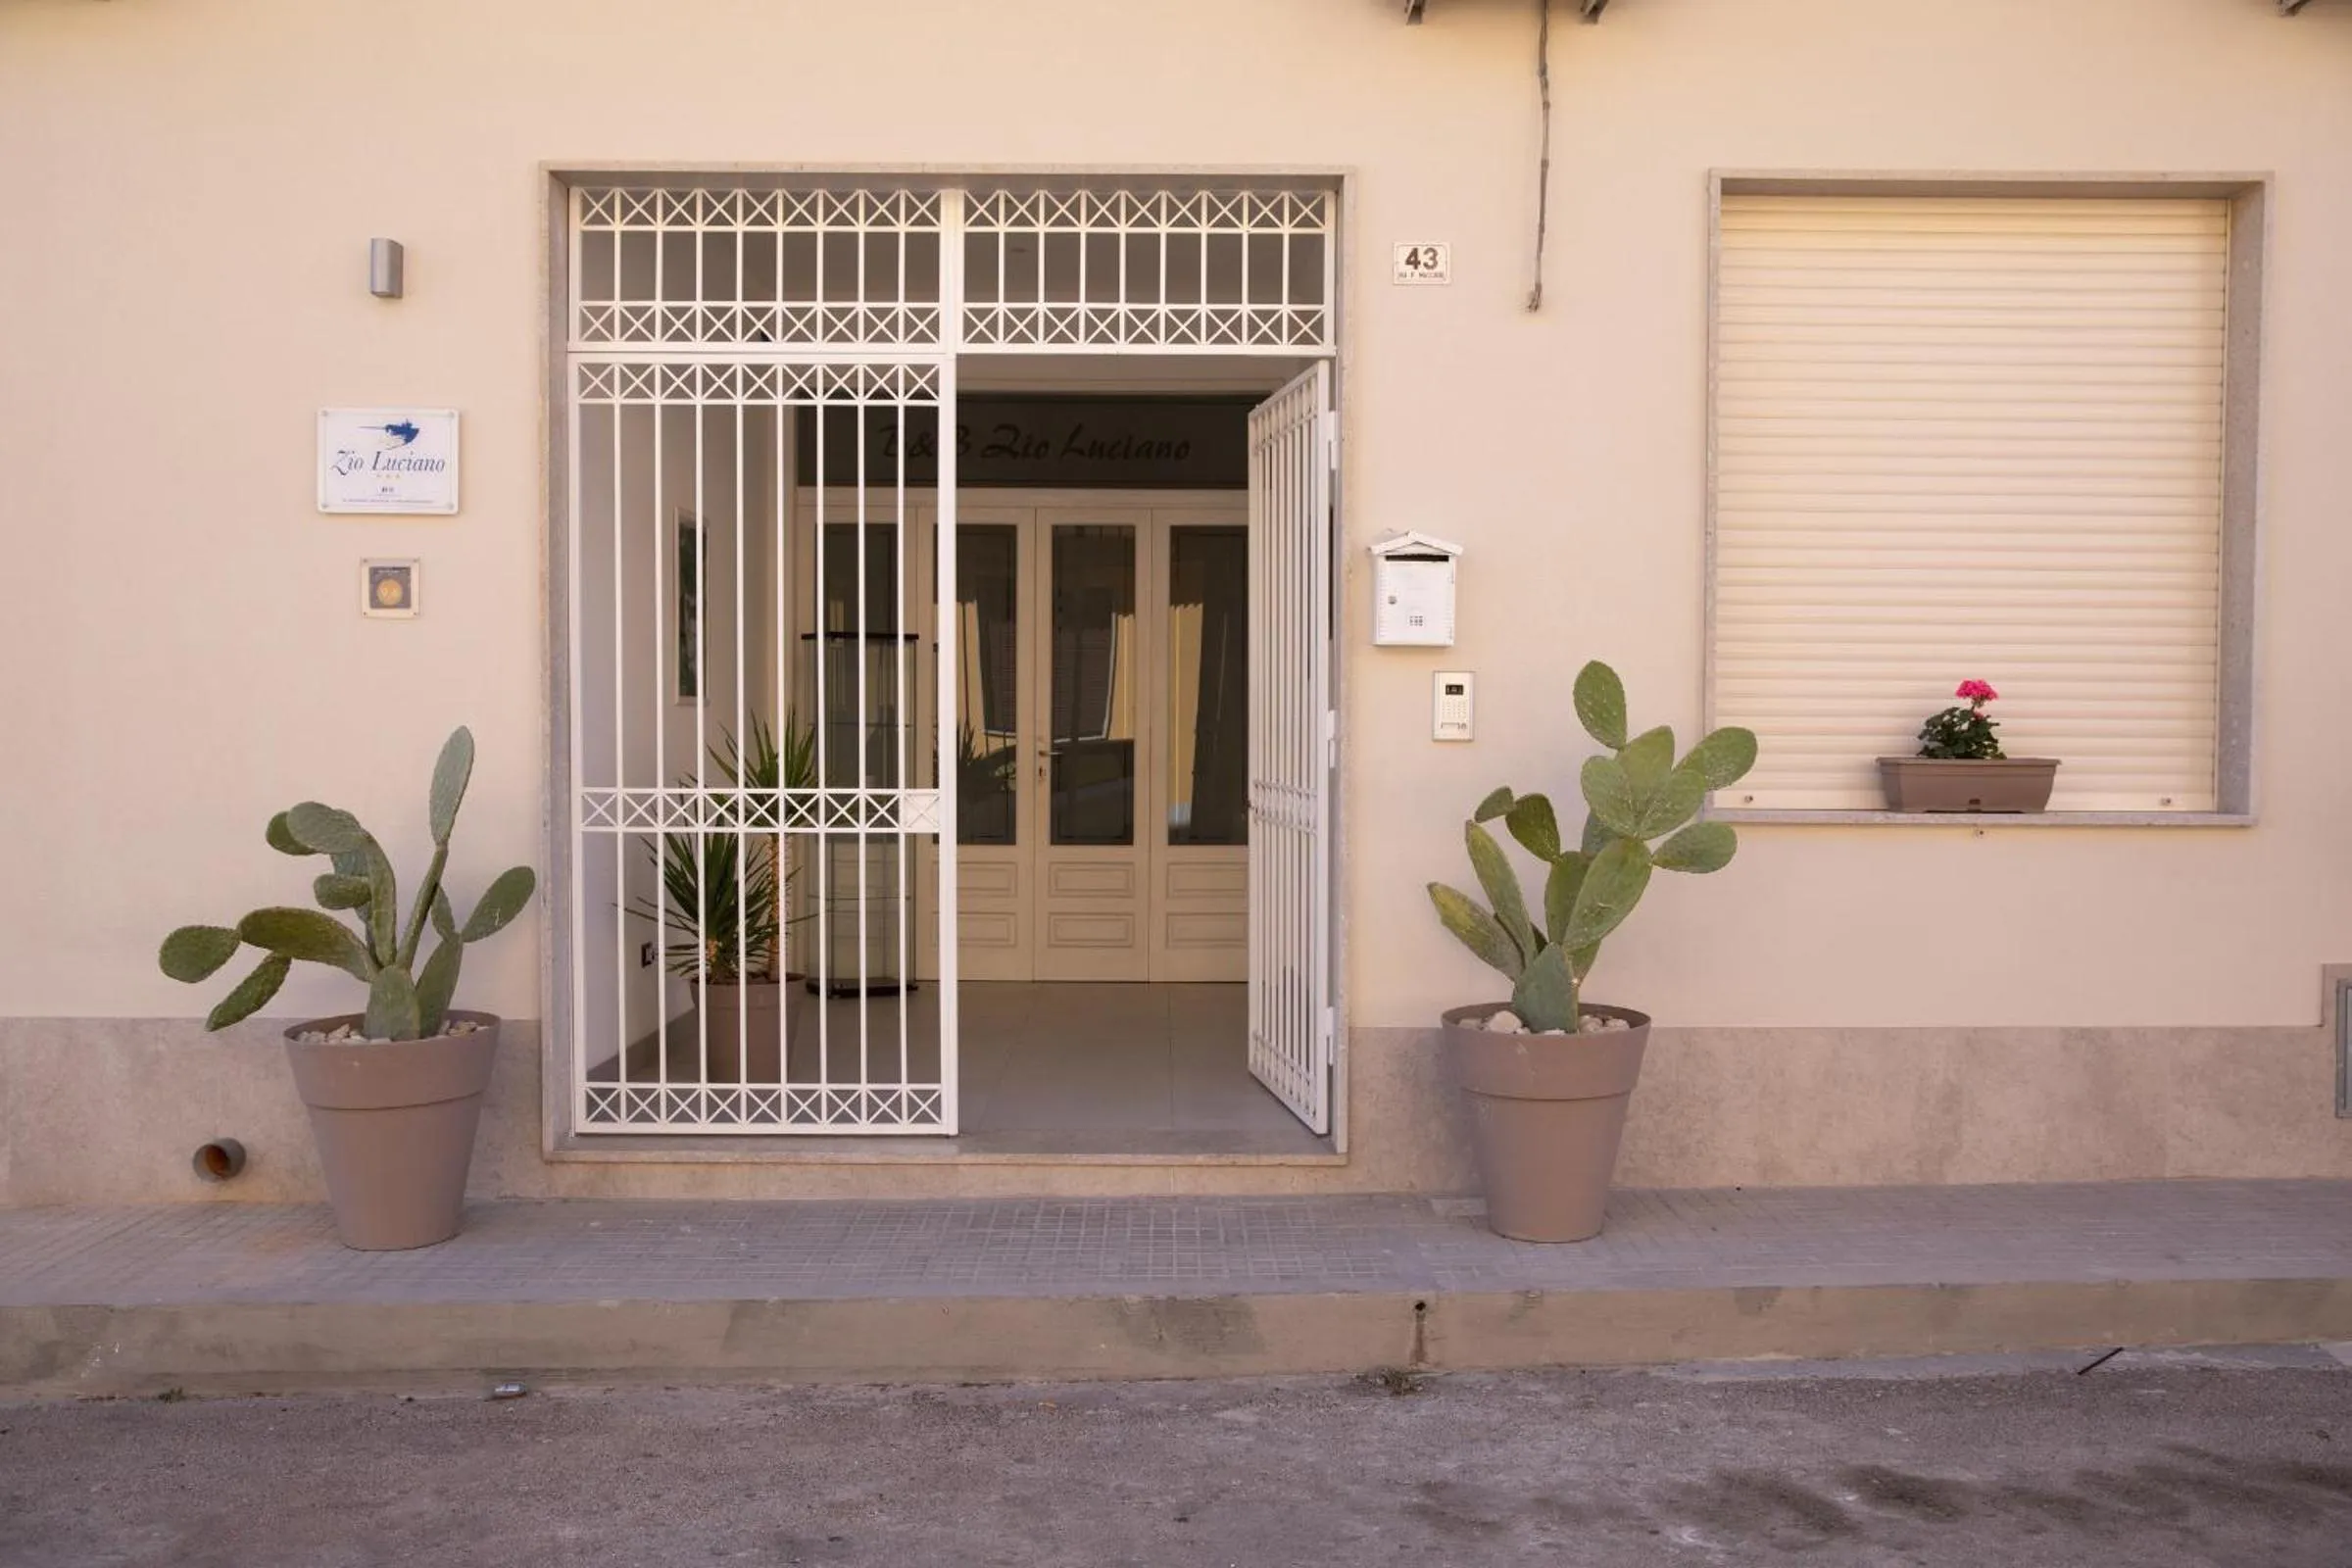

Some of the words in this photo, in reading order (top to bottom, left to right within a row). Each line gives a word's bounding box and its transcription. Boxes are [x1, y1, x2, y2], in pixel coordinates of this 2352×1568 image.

[1405, 247, 1438, 270] 43
[980, 422, 1051, 461] Zio
[1059, 419, 1192, 461] Luciano
[330, 450, 365, 476] Zio
[370, 450, 446, 472] Luciano
